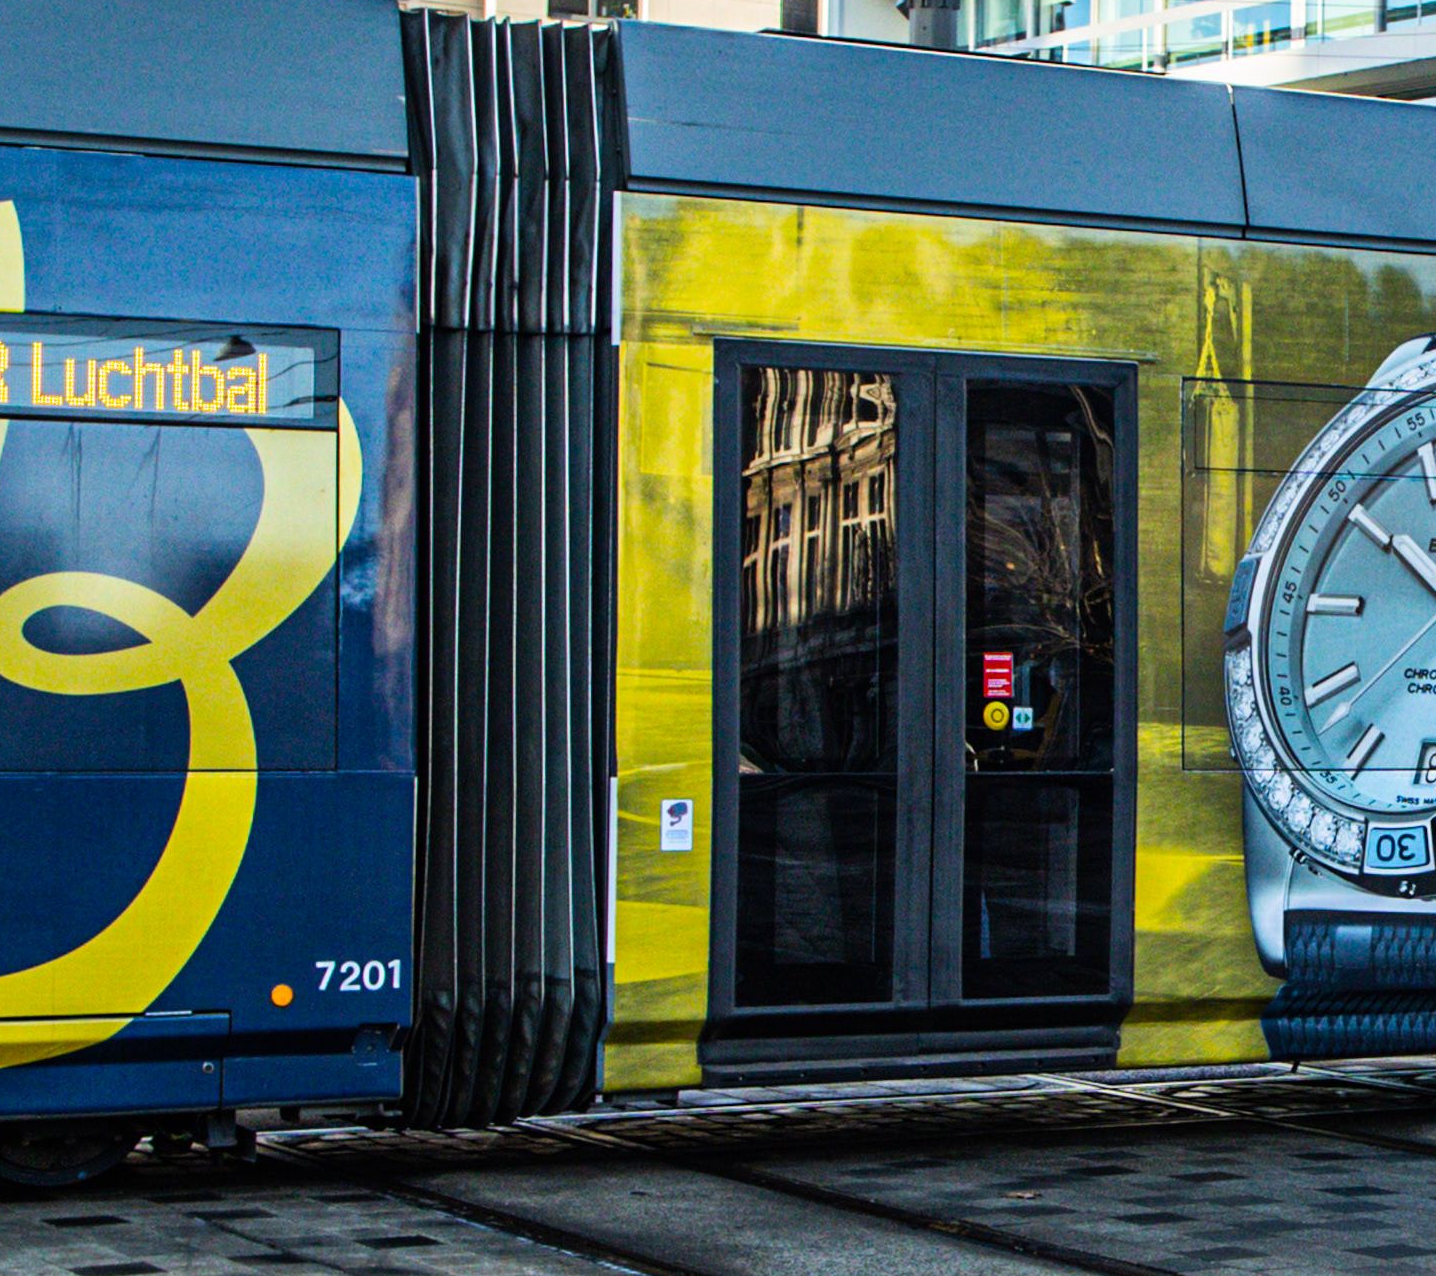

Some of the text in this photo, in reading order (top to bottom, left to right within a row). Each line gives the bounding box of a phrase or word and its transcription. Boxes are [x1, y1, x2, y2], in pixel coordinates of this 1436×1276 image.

[30, 342, 268, 415] Luchtbal
[1407, 415, 1425, 431] 55
[1328, 480, 1346, 502] 50
[1282, 581, 1297, 604] 45
[1279, 686, 1290, 706] 40
[1376, 834, 1416, 862] 30
[315, 959, 401, 991] 7201
